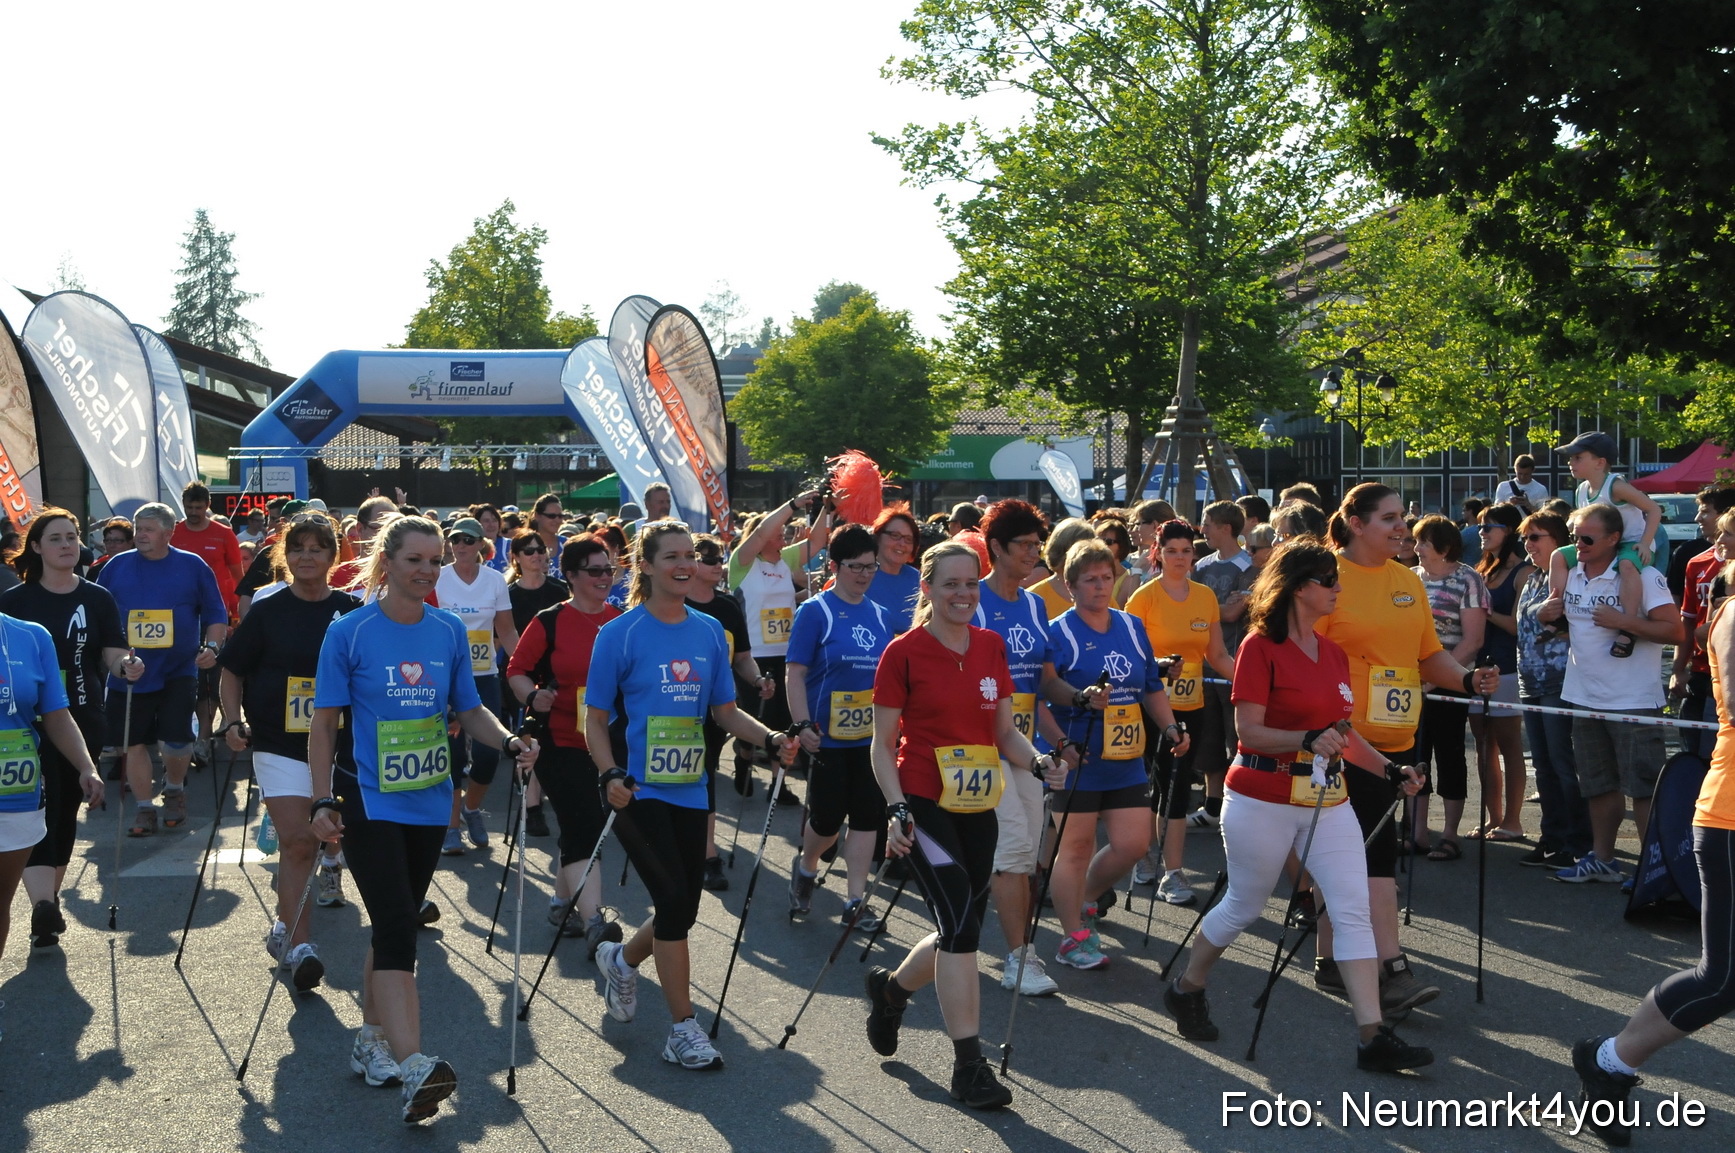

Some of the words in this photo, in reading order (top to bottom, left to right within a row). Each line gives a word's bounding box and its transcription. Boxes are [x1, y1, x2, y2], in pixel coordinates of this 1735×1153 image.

[438, 382, 514, 396] firmenlauf
[290, 406, 333, 416] Fischer
[134, 623, 166, 639] 129
[768, 619, 791, 635] 512
[471, 644, 489, 660] 92
[74, 632, 88, 705] RAIL.ONE
[386, 685, 436, 700] camping
[661, 681, 701, 694] camping
[1174, 678, 1196, 696] 60
[290, 697, 315, 718] 10
[1385, 688, 1411, 713] 63
[837, 707, 873, 728] 293
[1013, 713, 1031, 735] 96
[1111, 723, 1140, 747] 291
[384, 746, 448, 782] 5046
[650, 748, 703, 774] 5047
[0, 760, 35, 786] 50
[953, 769, 992, 797] 141
